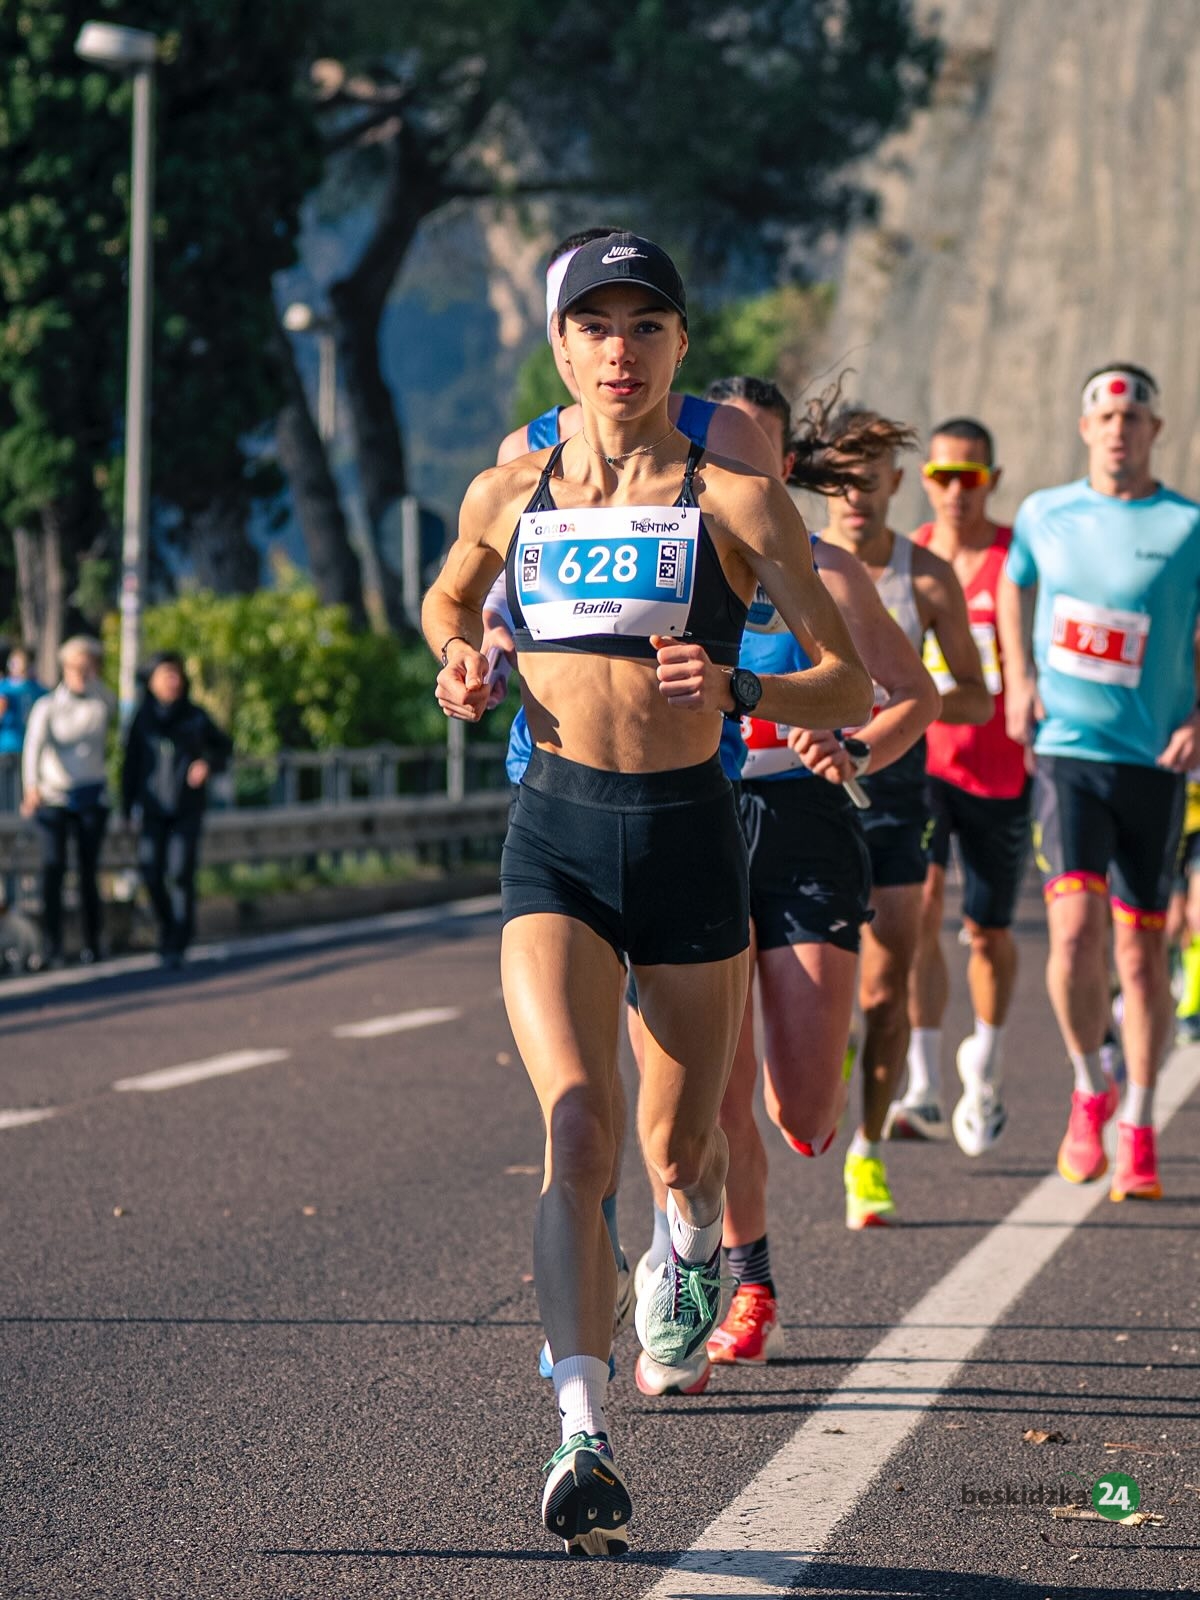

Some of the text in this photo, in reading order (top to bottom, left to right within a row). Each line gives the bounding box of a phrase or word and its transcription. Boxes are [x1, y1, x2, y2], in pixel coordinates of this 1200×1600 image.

[609, 246, 638, 257] NIKE
[557, 545, 639, 585] 628
[572, 600, 622, 615] Barilla
